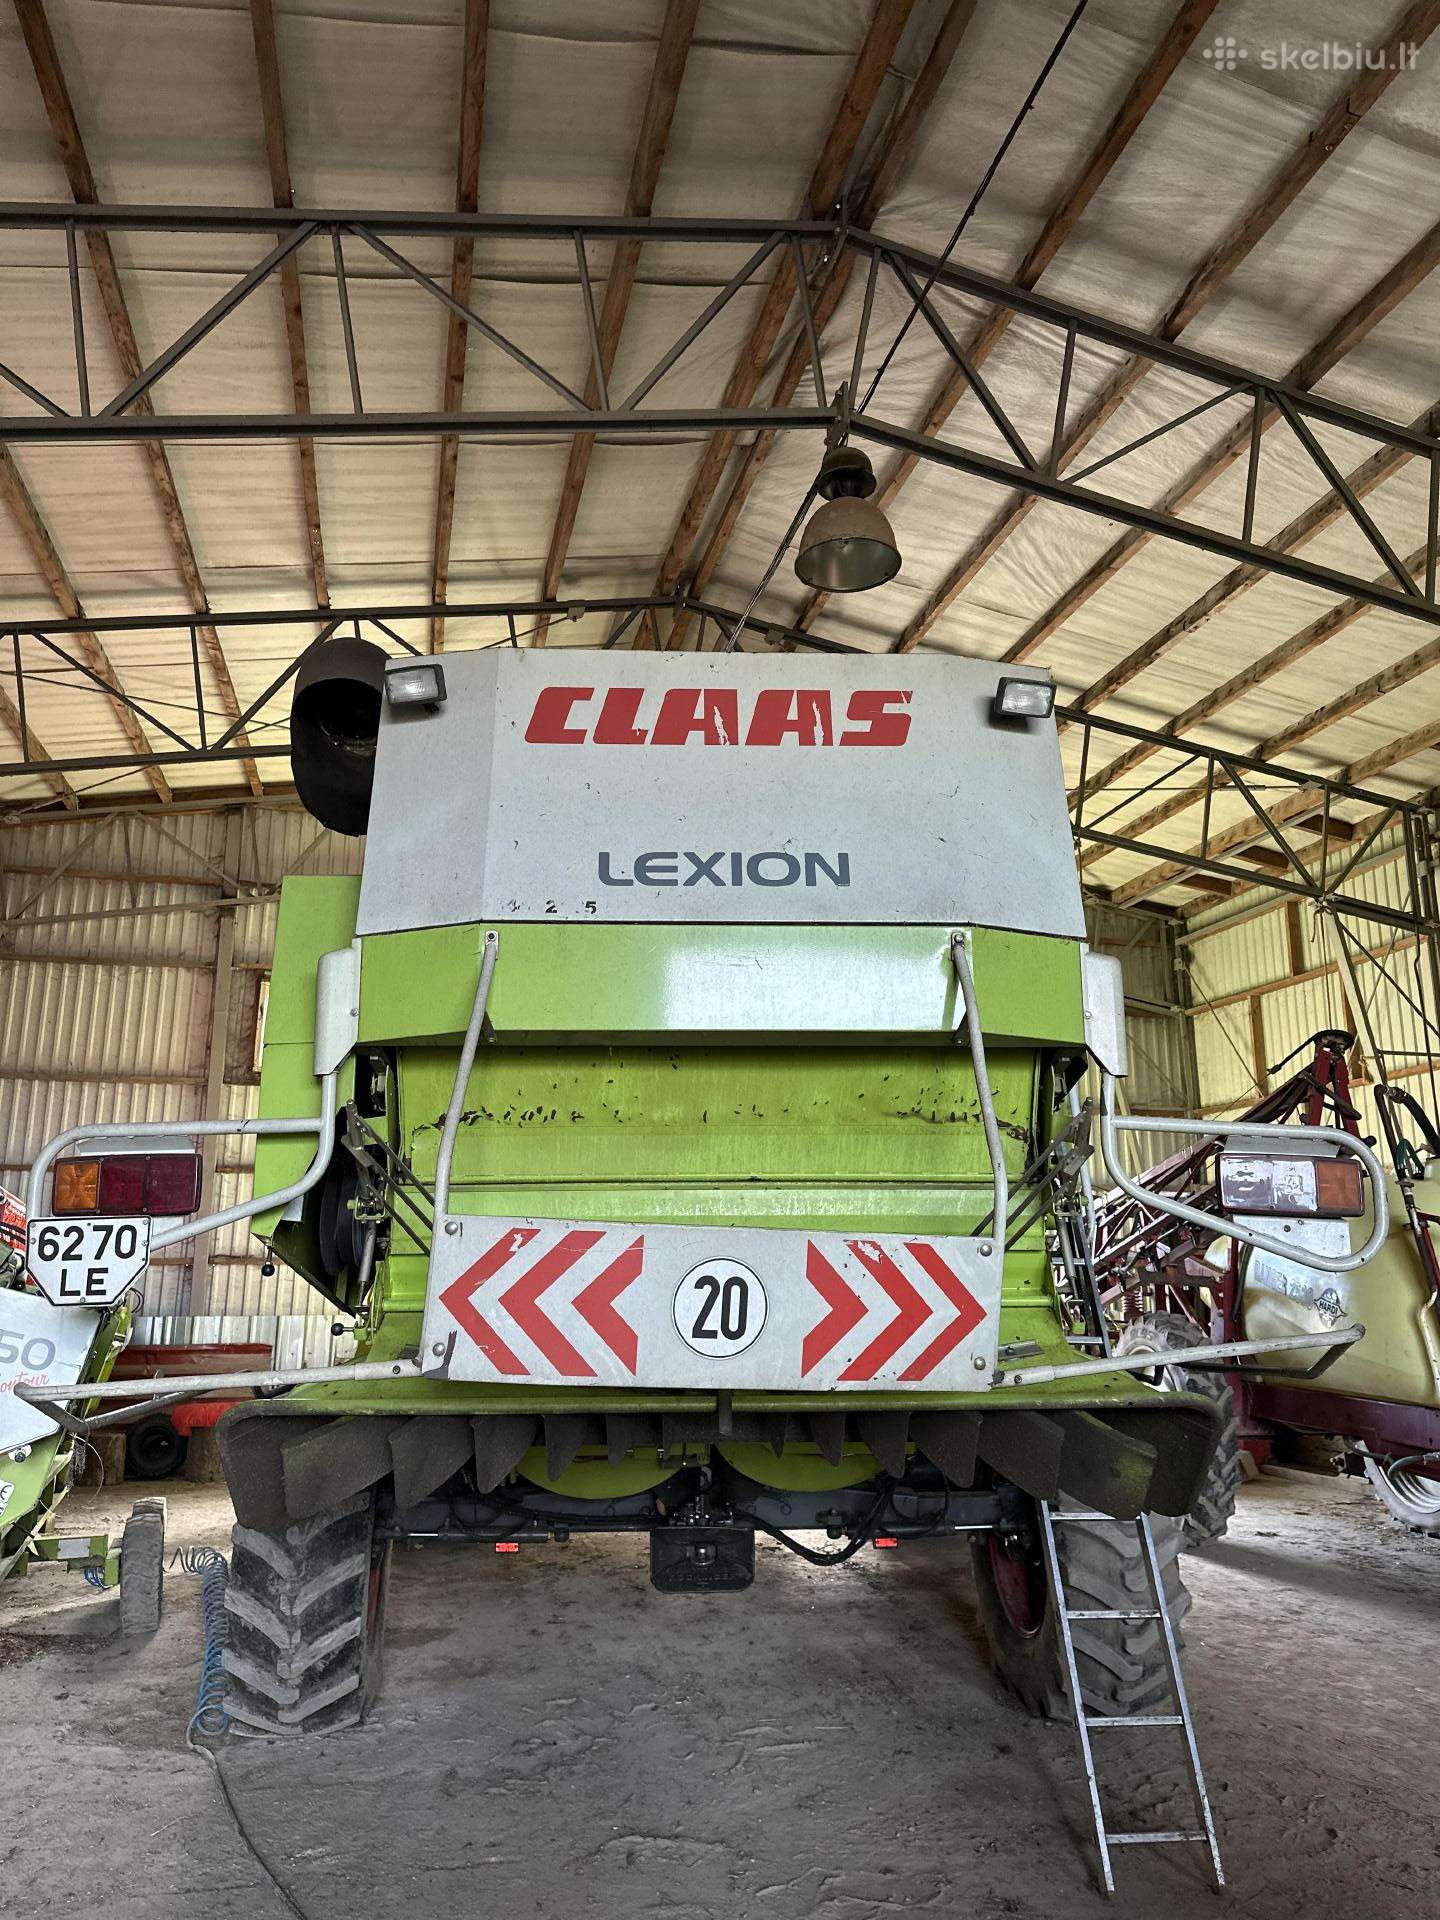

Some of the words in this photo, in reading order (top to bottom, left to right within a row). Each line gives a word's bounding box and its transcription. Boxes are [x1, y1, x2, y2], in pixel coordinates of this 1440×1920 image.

[524, 686, 914, 747] CLAAS
[598, 851, 851, 887] LEXION
[38, 1224, 137, 1261] 6270
[60, 1267, 109, 1297] LE
[691, 1274, 749, 1341] 20
